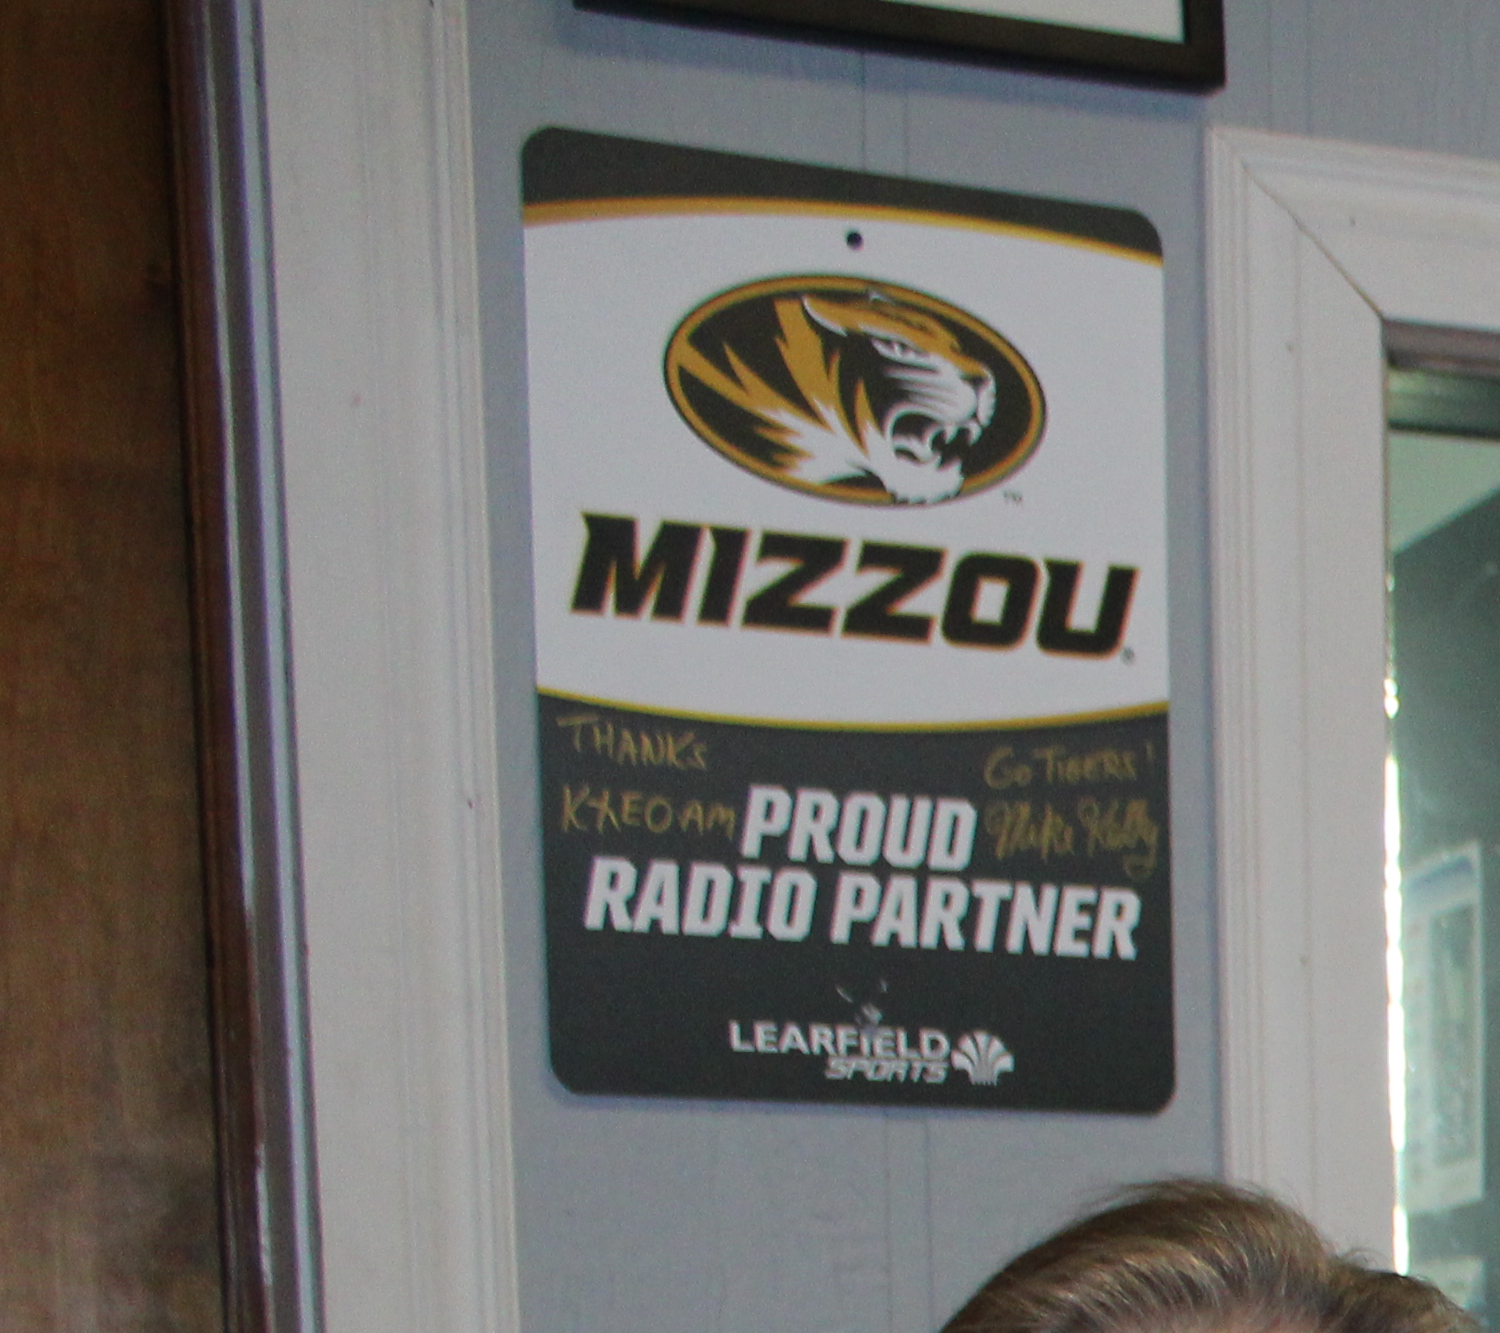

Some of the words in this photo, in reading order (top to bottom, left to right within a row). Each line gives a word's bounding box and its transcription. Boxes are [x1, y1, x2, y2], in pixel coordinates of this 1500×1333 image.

[571, 512, 1141, 661] MIZZOU
[741, 783, 978, 871] PROUD
[584, 855, 819, 941] RADIO
[830, 870, 1141, 961] PARTNER
[729, 1019, 950, 1059] LEARFIELD
[825, 1053, 948, 1083] SPORTS
